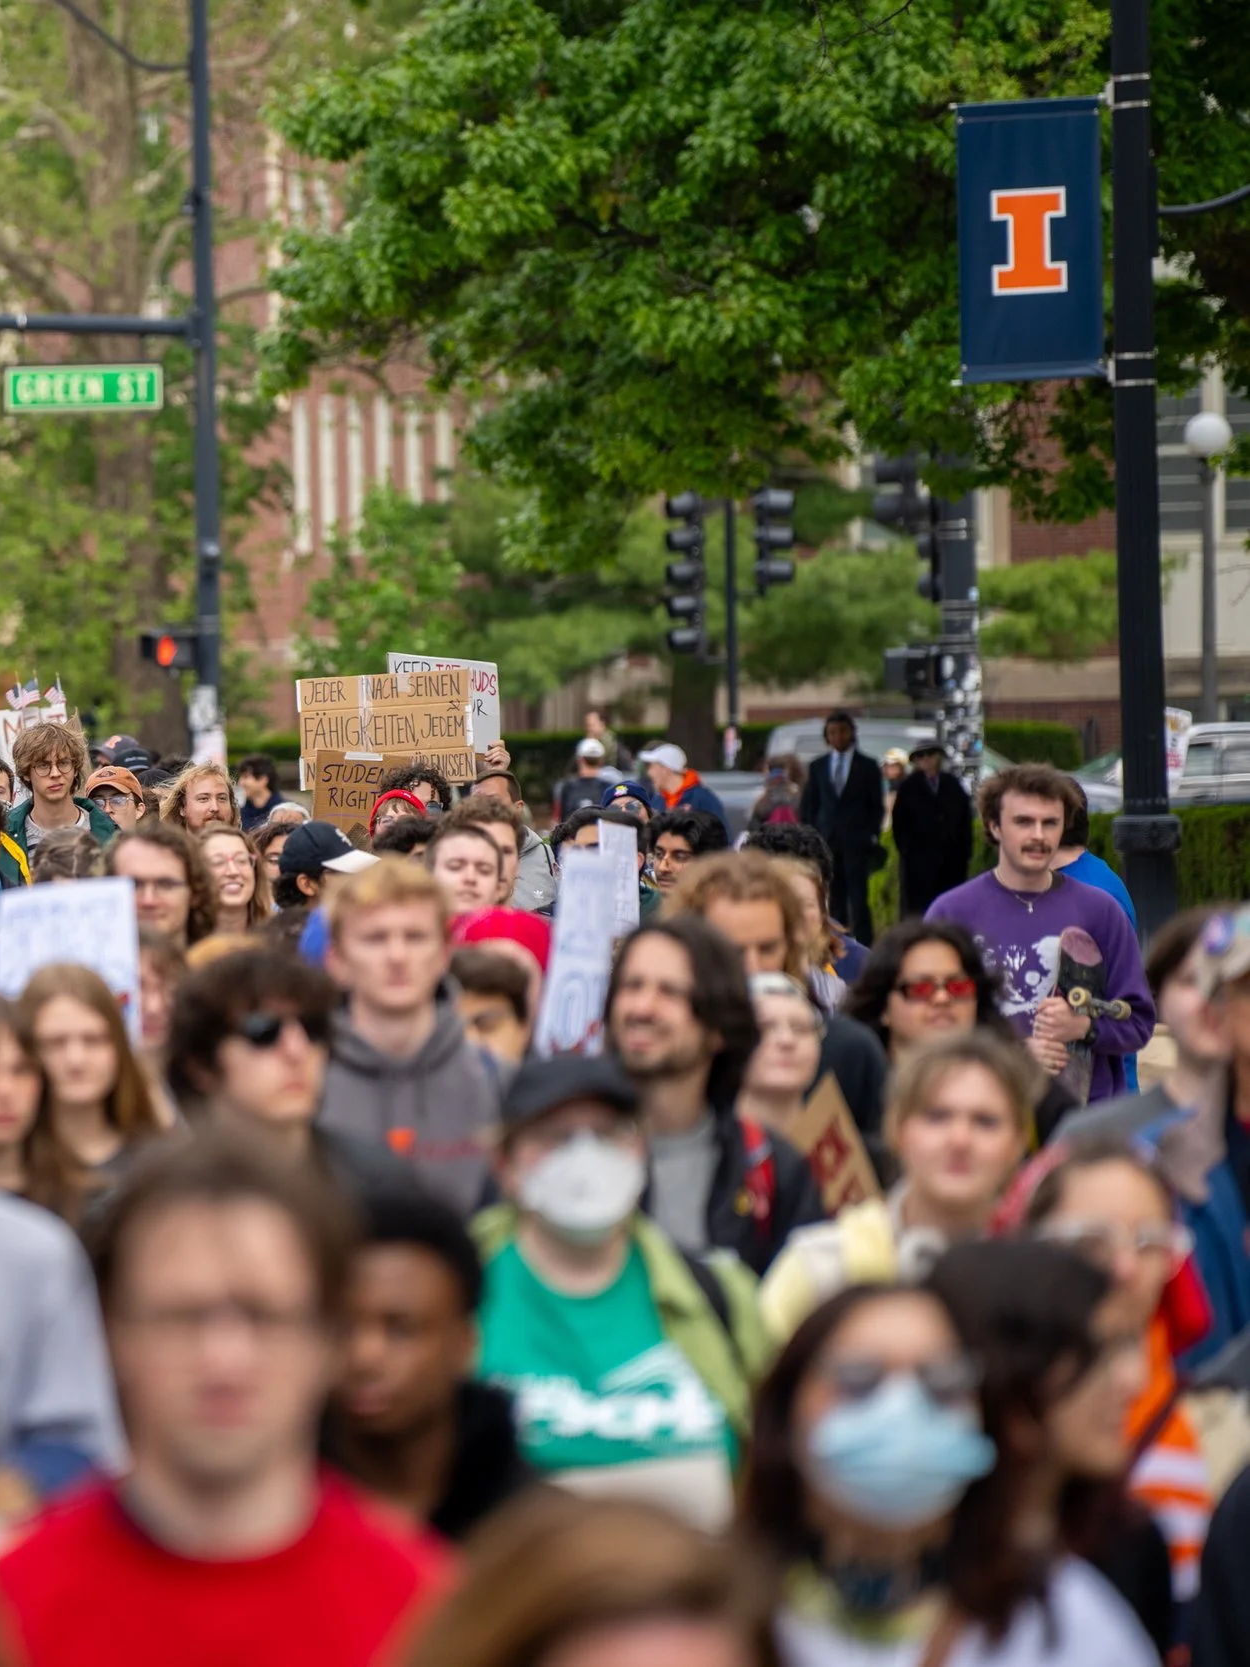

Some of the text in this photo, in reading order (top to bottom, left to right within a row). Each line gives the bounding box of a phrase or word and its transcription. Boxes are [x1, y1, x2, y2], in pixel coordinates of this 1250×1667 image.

[990, 186, 1068, 297] I
[16, 373, 150, 403] GREEN ST
[304, 672, 461, 705] JEDER NACH SEINEN
[304, 711, 465, 750] FÄHIGKEITEN, JEDEM
